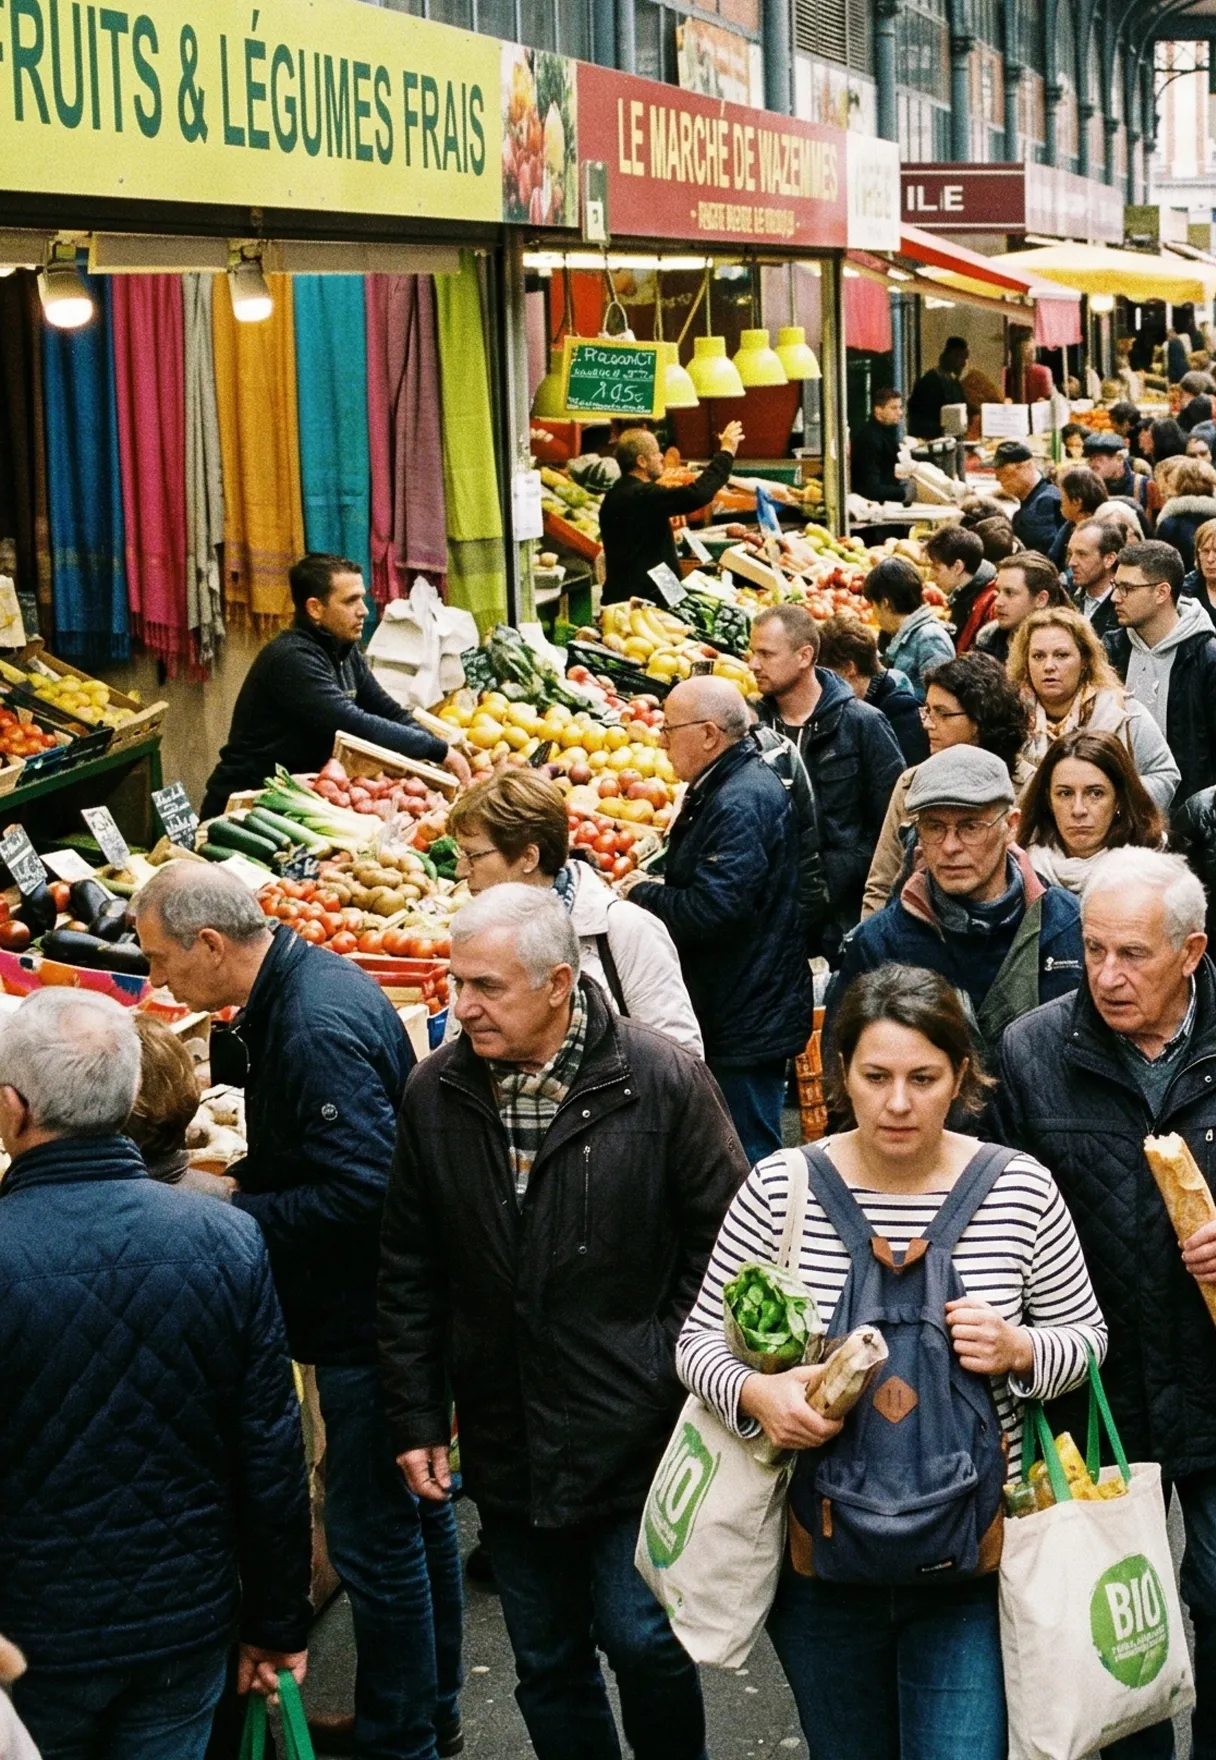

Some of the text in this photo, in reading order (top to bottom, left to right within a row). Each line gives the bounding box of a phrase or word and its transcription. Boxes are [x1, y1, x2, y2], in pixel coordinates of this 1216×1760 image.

[0, 0, 486, 176] RUITS & LÉGUMES FRAIS
[618, 97, 645, 177] LE
[649, 100, 730, 188] MARCHÉ
[732, 122, 756, 192] DE
[758, 128, 838, 203] WAZEMMES
[1104, 1567, 1161, 1641] BIO
